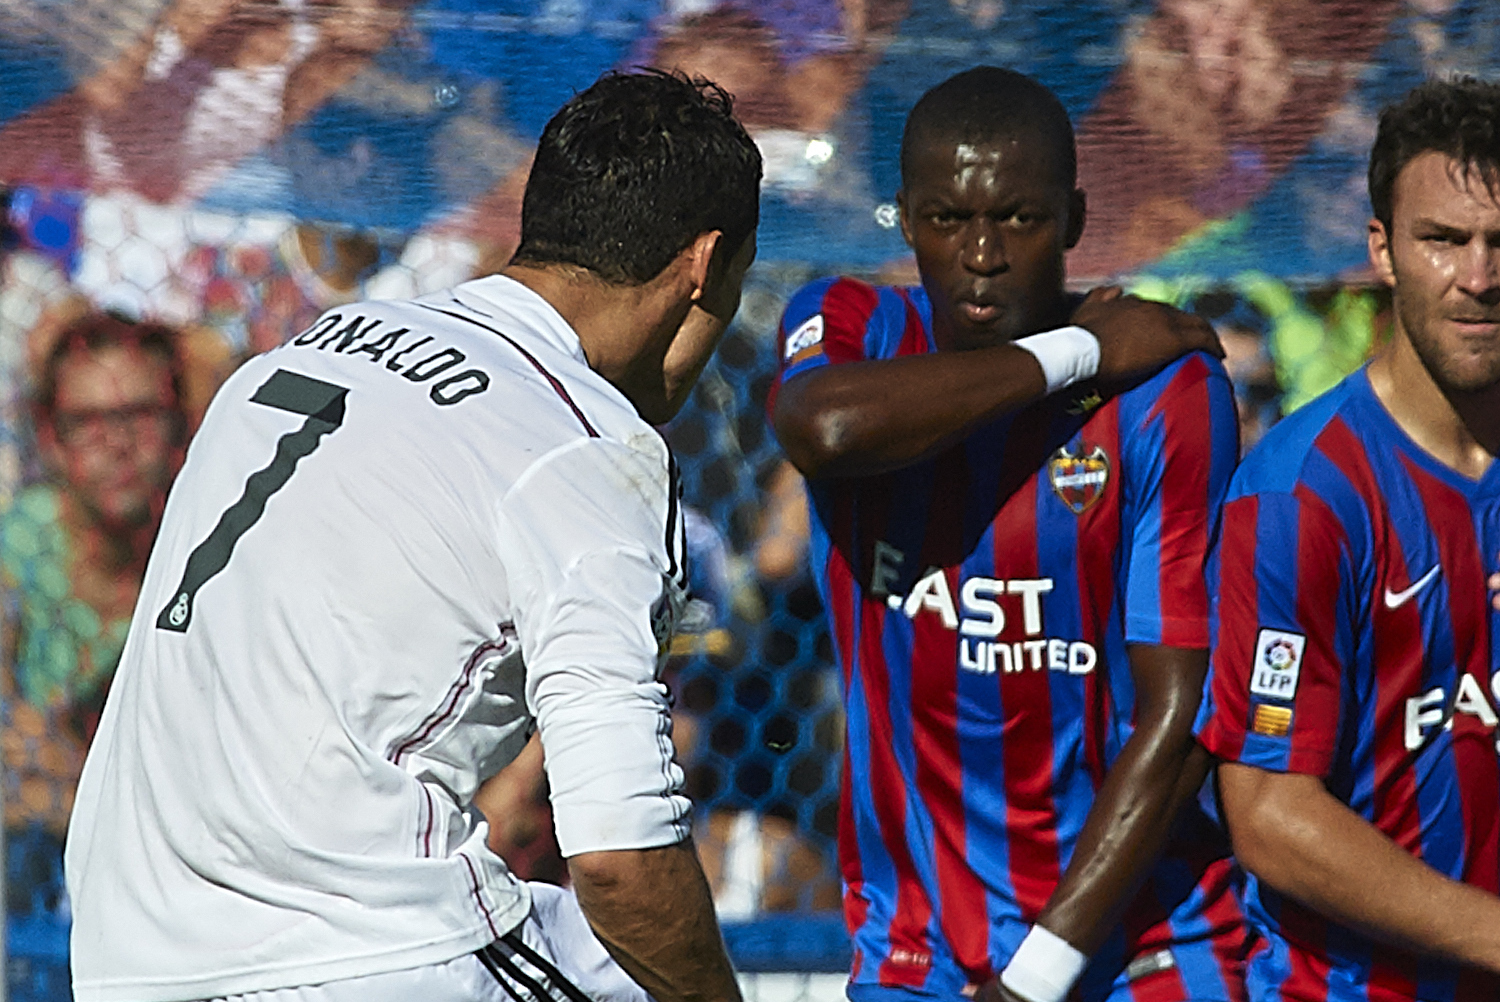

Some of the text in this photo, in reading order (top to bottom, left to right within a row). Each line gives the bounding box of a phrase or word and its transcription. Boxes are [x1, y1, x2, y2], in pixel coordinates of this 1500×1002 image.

[279, 313, 490, 406] ONALDO
[156, 369, 351, 634] 7
[1258, 671, 1293, 691] LFP
